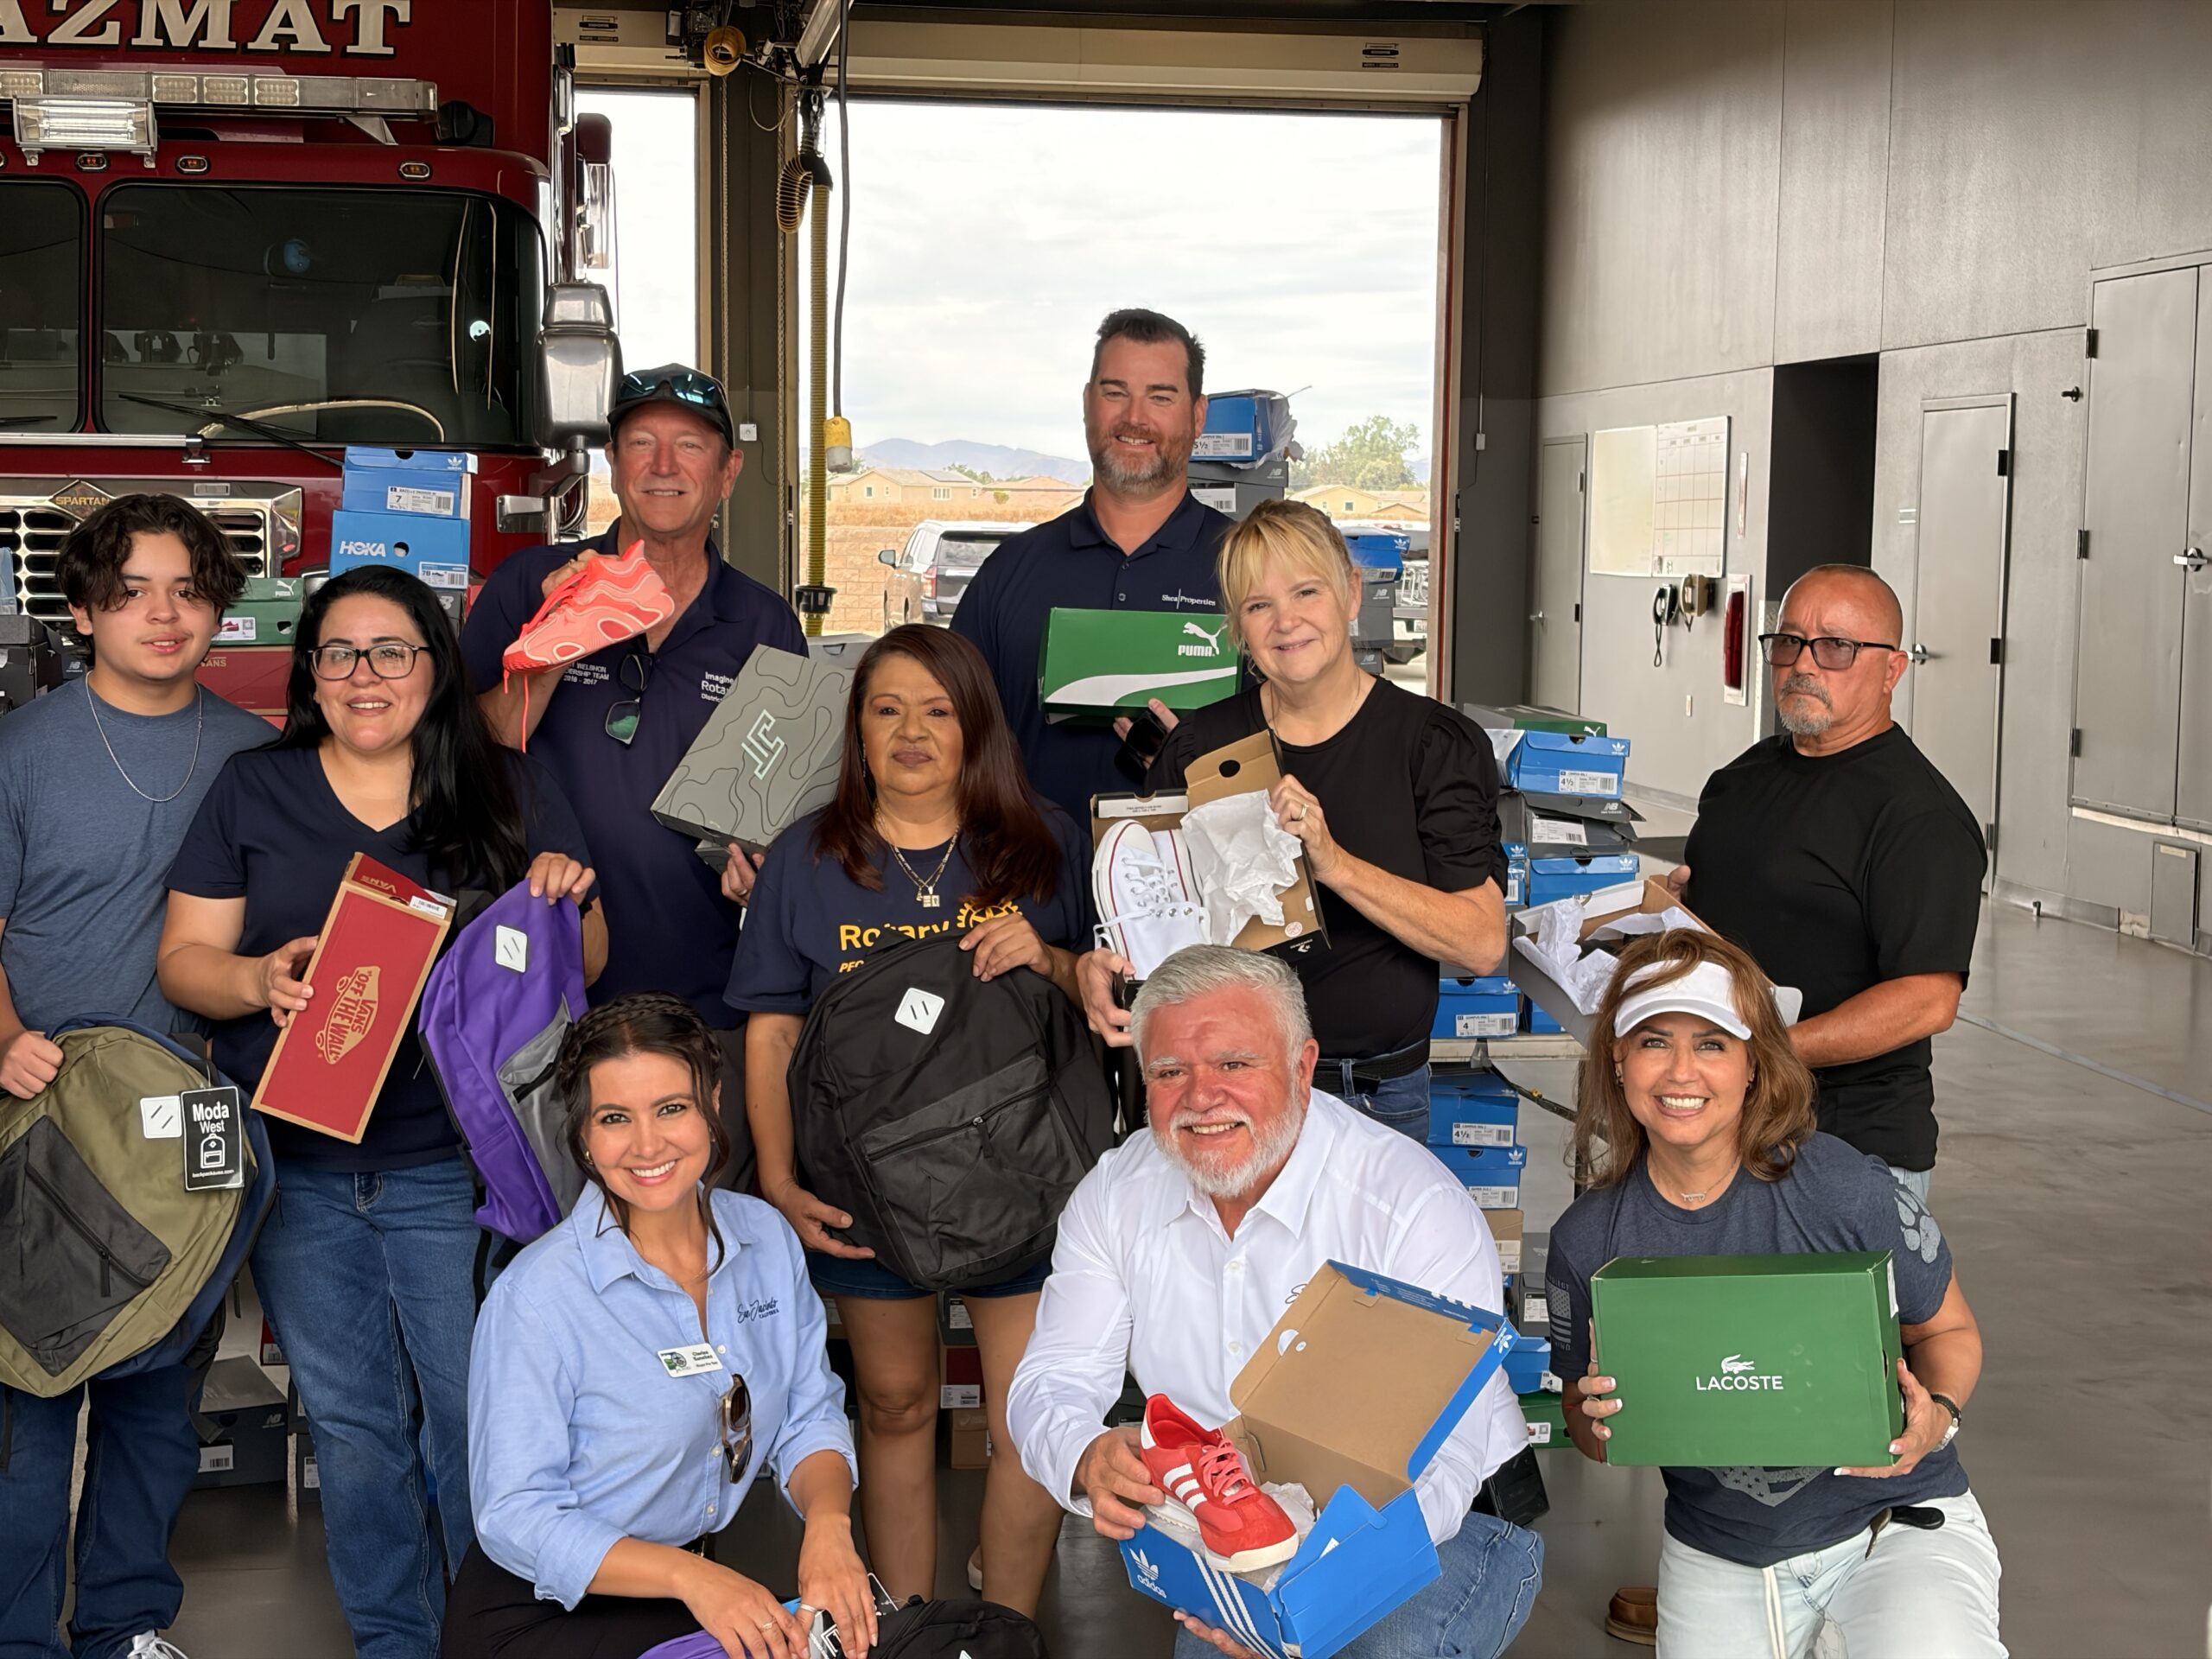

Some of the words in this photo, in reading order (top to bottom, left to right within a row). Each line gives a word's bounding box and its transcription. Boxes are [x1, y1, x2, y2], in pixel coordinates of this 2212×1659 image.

[55, 497, 110, 505] SPARTAN
[339, 540, 386, 557] HOKA
[1179, 595, 1216, 607] Properties
[1178, 645, 1213, 657] PUMA
[705, 671, 734, 683] Imagine
[702, 680, 726, 695] Rota
[352, 1000, 378, 1035] VANS
[193, 1101, 230, 1122] Moda
[200, 1120, 225, 1134] West
[1695, 1376, 1784, 1391] LACOSTE
[1137, 1574, 1166, 1599] adidas
